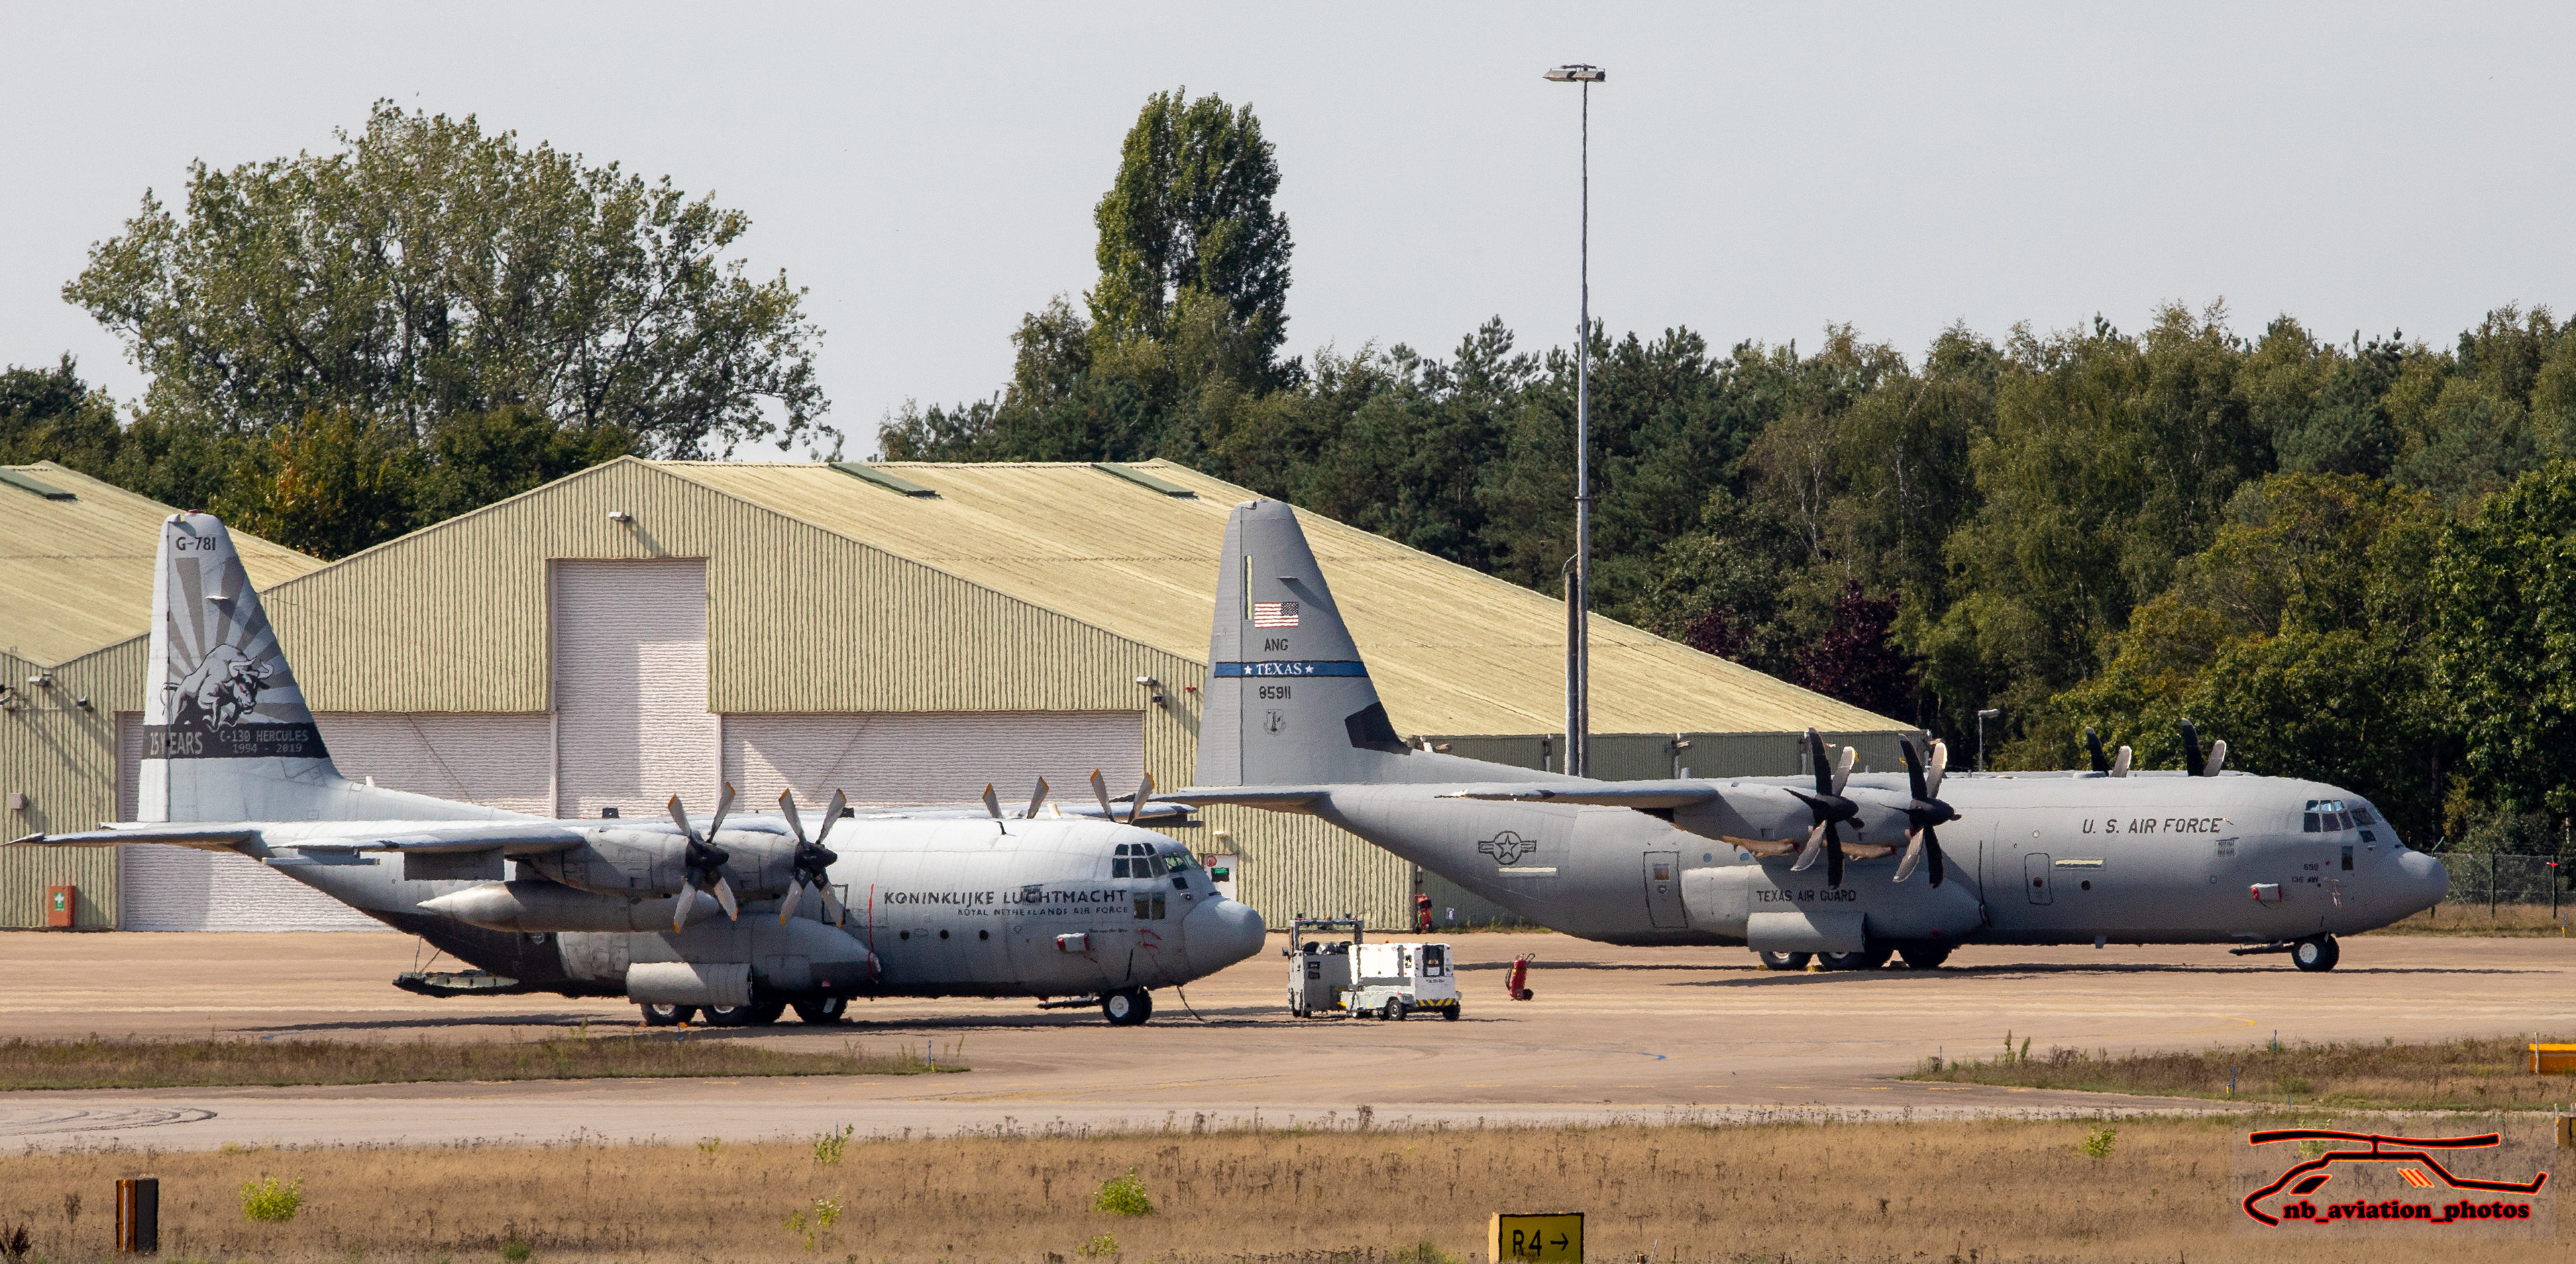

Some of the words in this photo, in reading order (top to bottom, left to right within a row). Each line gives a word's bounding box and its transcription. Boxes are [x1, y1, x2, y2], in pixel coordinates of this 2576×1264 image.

[176, 537, 216, 551] G-781
[1264, 638, 1289, 651] ANG
[1256, 662, 1303, 676] TEXAS
[1259, 686, 1292, 700] 85911
[160, 731, 203, 755] YEARS
[219, 729, 251, 743] C-130
[256, 730, 309, 742] HERCULES
[232, 743, 258, 753] 1994
[276, 743, 303, 753] 2019
[2082, 819, 2096, 834] U.
[2105, 819, 2120, 834] S.
[2128, 818, 2157, 834] AIR
[2163, 817, 2223, 833] FORCE
[883, 890, 995, 908] KONINKLIJKE
[1003, 889, 1128, 904] LUCHTMACHT
[1756, 890, 1792, 902] TEXAS
[1797, 890, 1815, 902] AIR
[1820, 890, 1857, 902] GUARD
[957, 908, 989, 916] ROYAL
[994, 908, 1067, 916] NETHERLANDS
[1073, 907, 1090, 915] AIR
[1095, 906, 1128, 914] FORCE
[1512, 1228, 1543, 1257] R4
